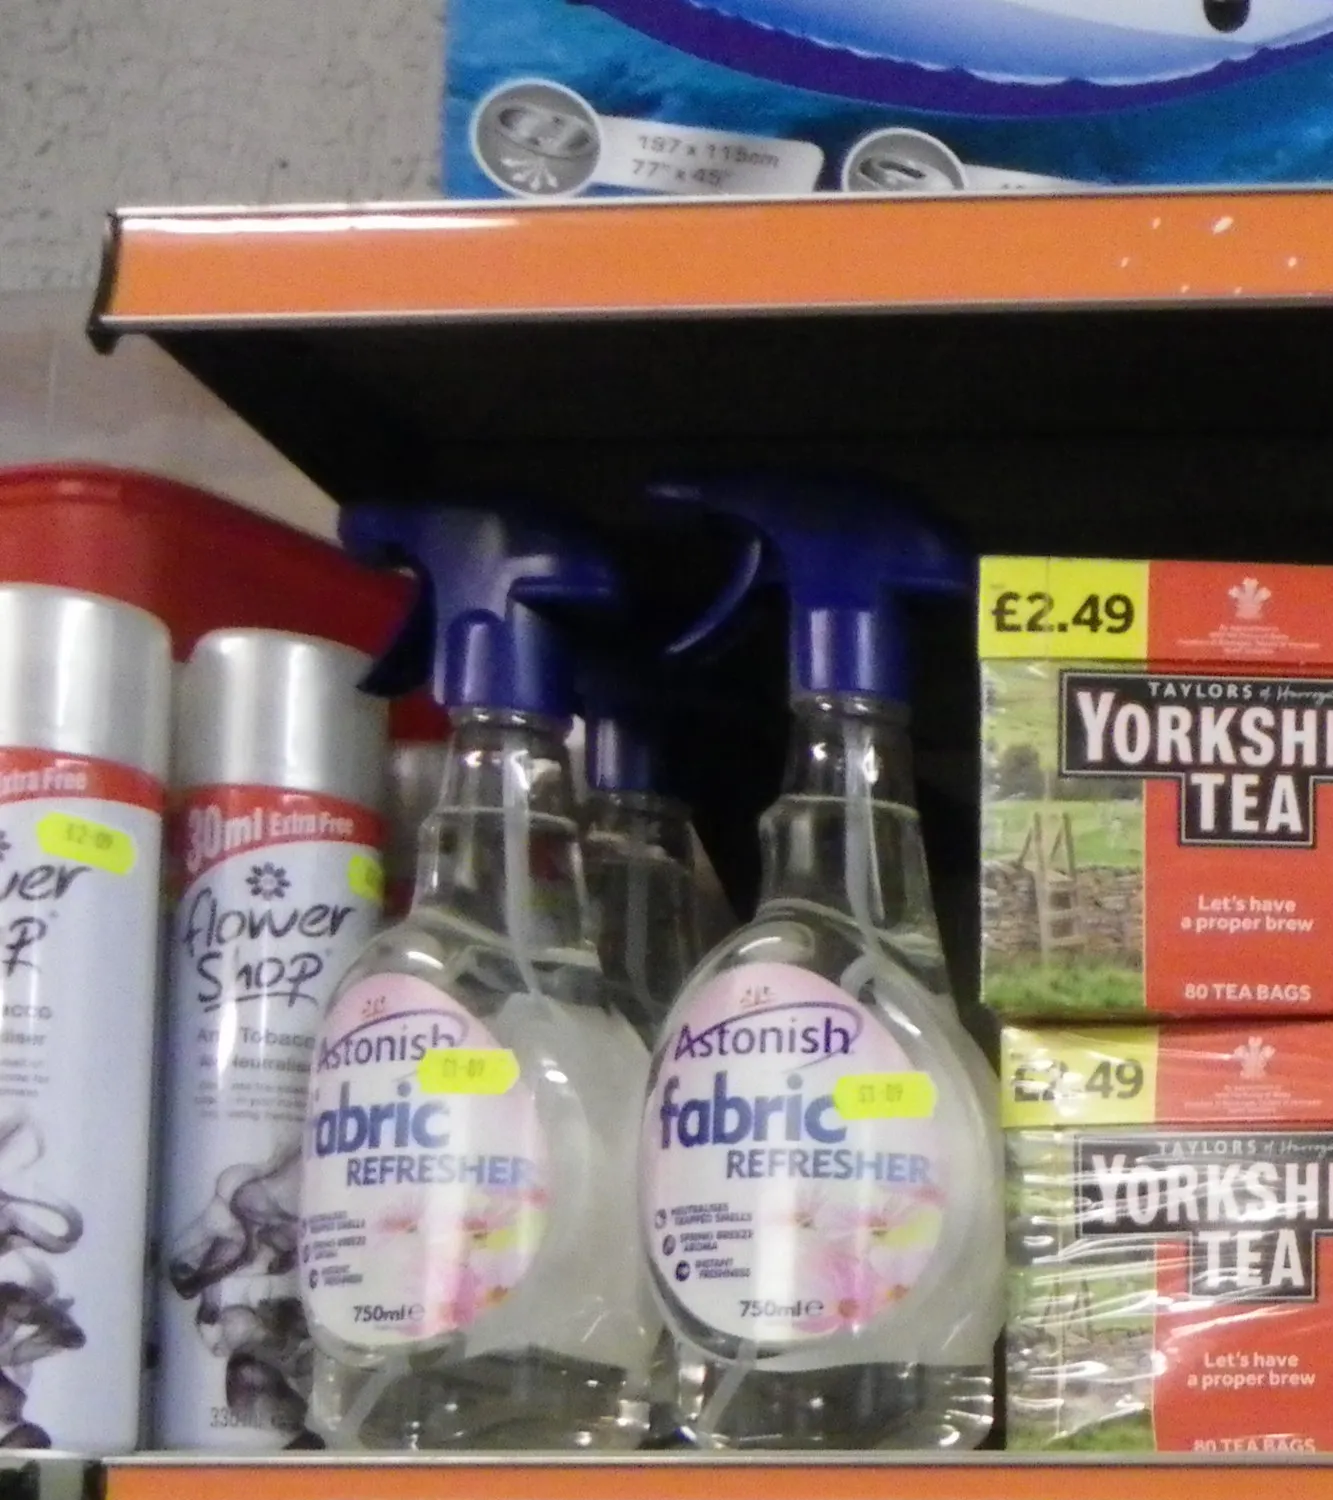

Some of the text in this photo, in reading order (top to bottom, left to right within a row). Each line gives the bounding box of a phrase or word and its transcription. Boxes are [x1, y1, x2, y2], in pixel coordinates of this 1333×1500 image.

[992, 593, 1135, 634] £2.49
[1148, 681, 1252, 700] TAYLORS
[1192, 773, 1304, 833] TEA
[1199, 896, 1296, 914] Let's have
[1196, 916, 1313, 935] proper brew
[1185, 983, 1311, 1002] 80 TEA BAGS
[674, 1014, 855, 1058] Astonish
[659, 1070, 848, 1148] fabric
[346, 1152, 543, 1187] REFRESHER
[726, 1148, 934, 1184] REFRESHER
[1198, 1229, 1306, 1287] TEA
[353, 1303, 407, 1324] 750ml
[1204, 1351, 1299, 1368] Let's have
[1202, 1370, 1315, 1389] proper brew
